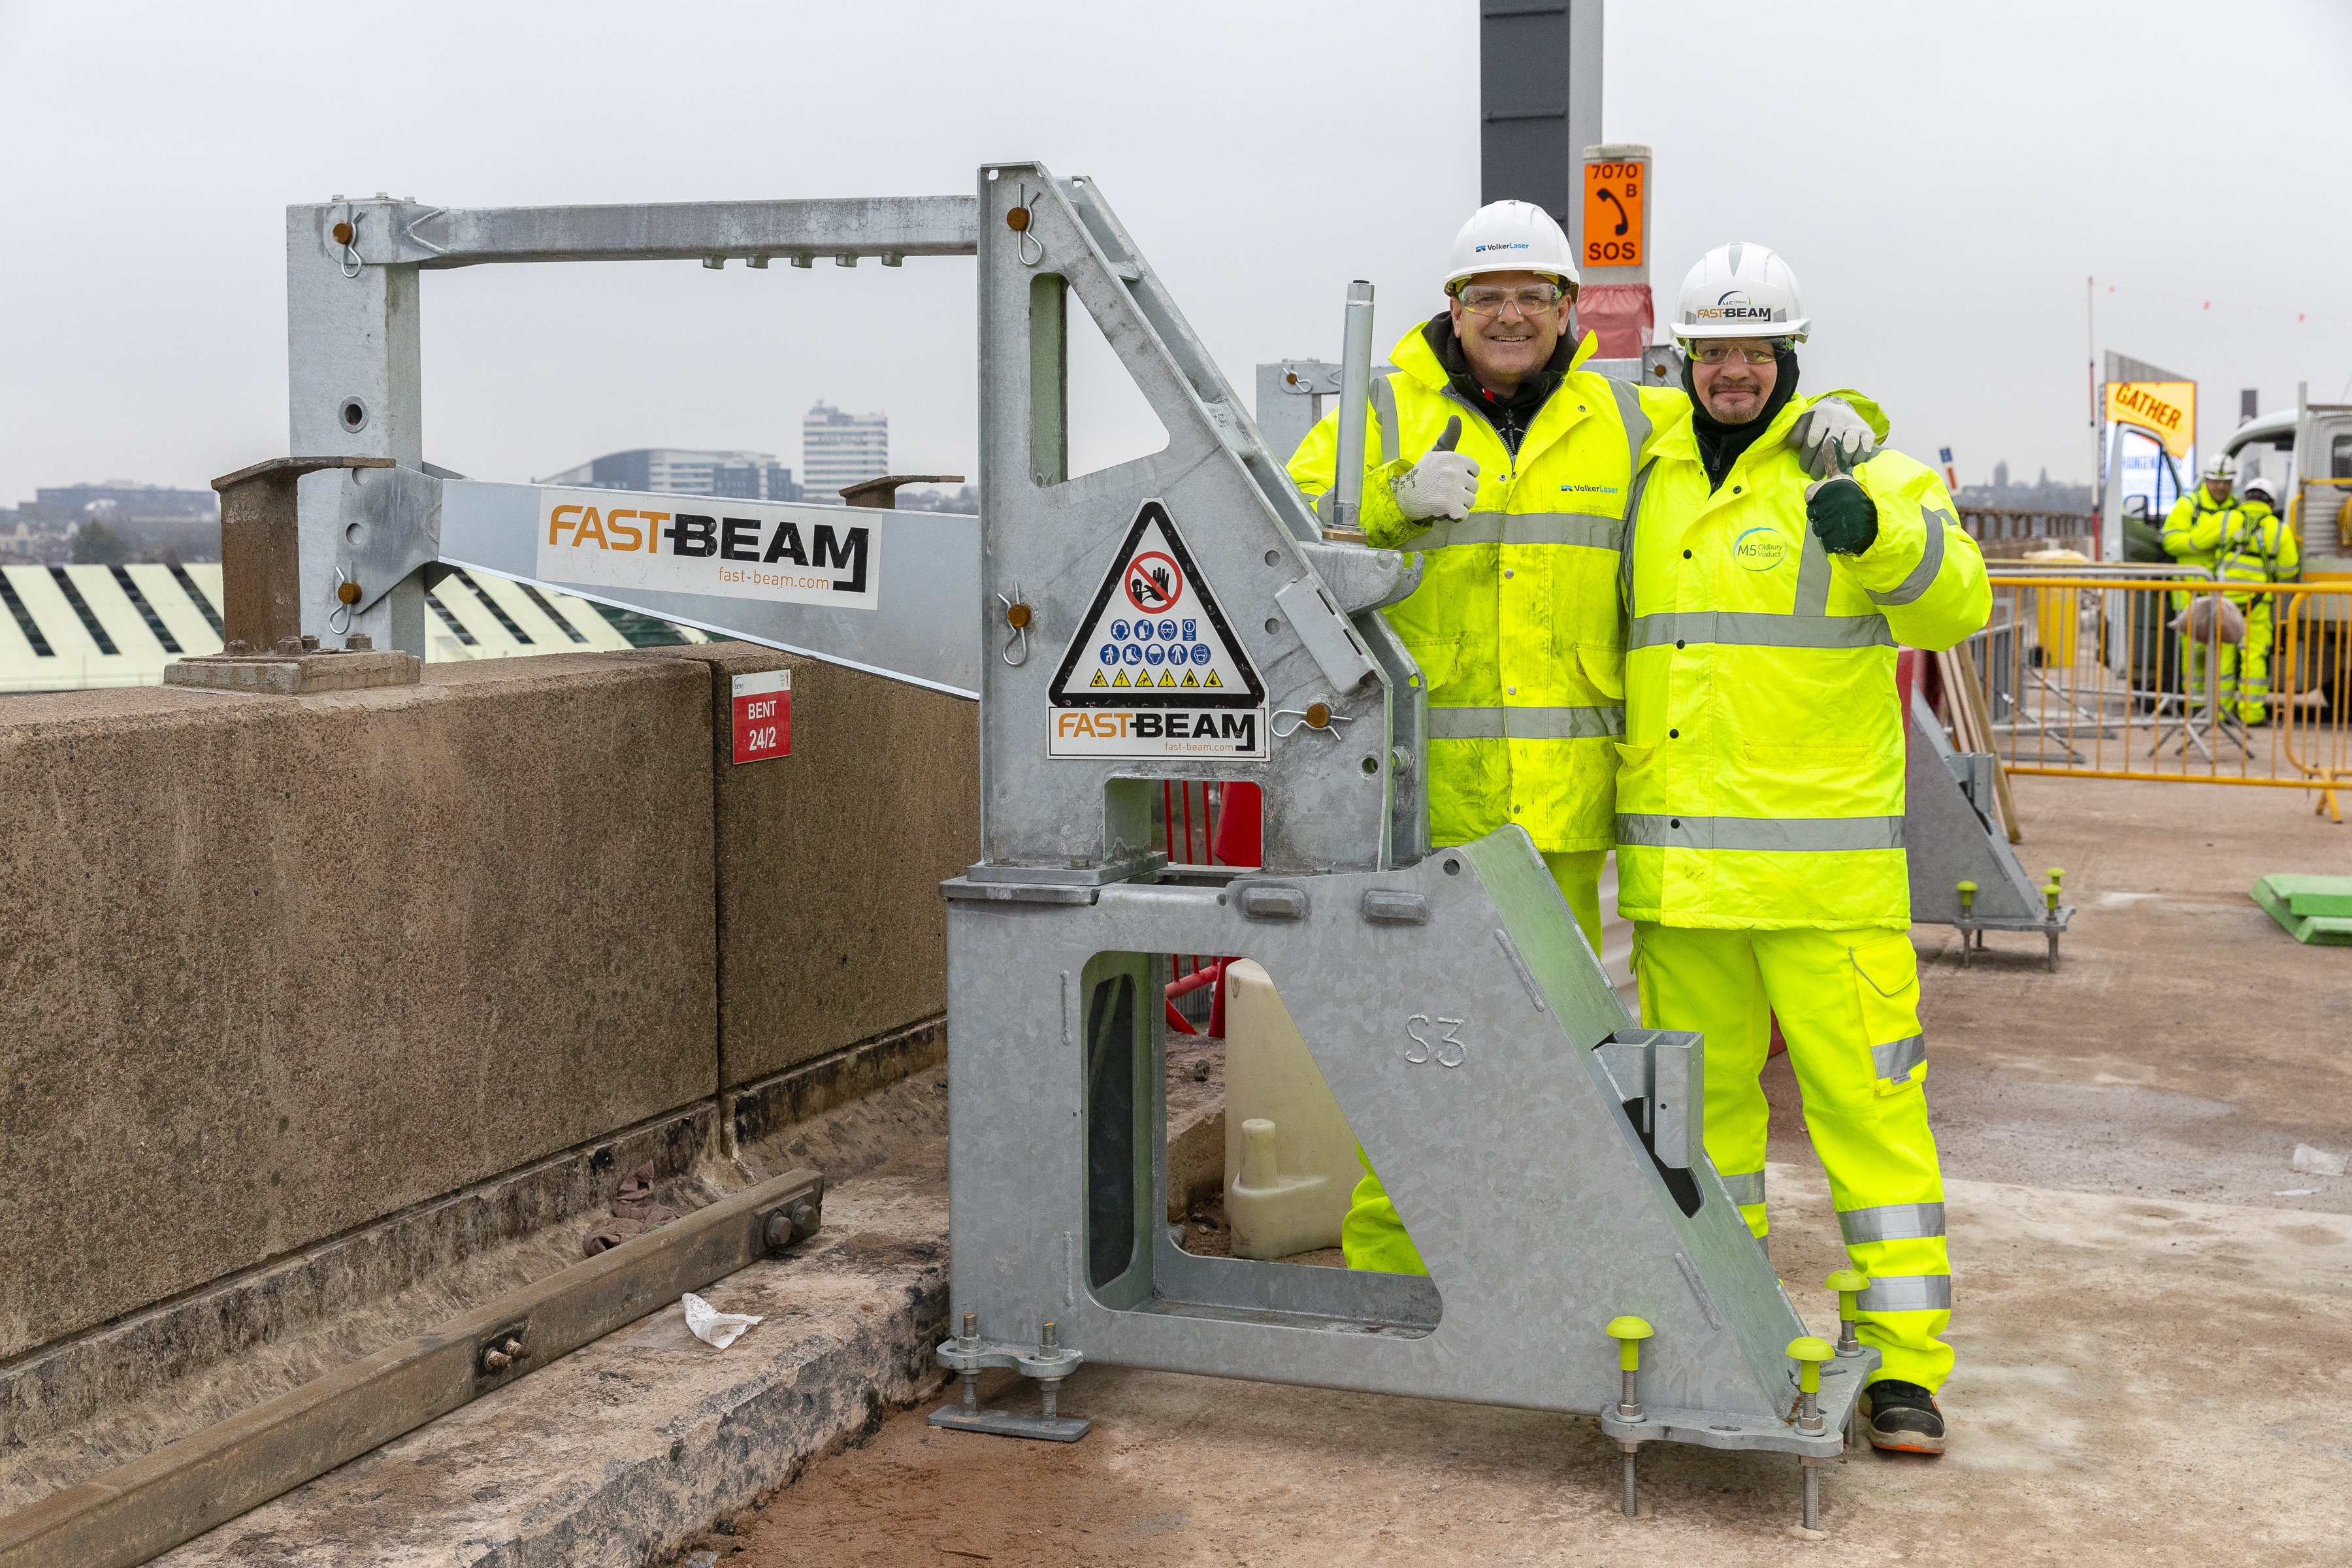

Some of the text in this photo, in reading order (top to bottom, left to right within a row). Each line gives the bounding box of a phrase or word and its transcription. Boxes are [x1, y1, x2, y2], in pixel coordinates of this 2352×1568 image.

[1592, 164, 1637, 179] 7070
[1626, 183, 1637, 197] B
[1488, 242, 1529, 251] VolkerLaser
[1589, 242, 1635, 261] SOS
[2115, 384, 2182, 431] GATHER
[1574, 485, 1618, 494] VolkerLaser
[1737, 544, 1757, 556] M5
[718, 566, 830, 591] fast-beam.com
[748, 700, 777, 720] BENT
[749, 727, 776, 751] 24/2
[1164, 742, 1234, 752] fast-beam.com
[1405, 1014, 1467, 1068] S3
